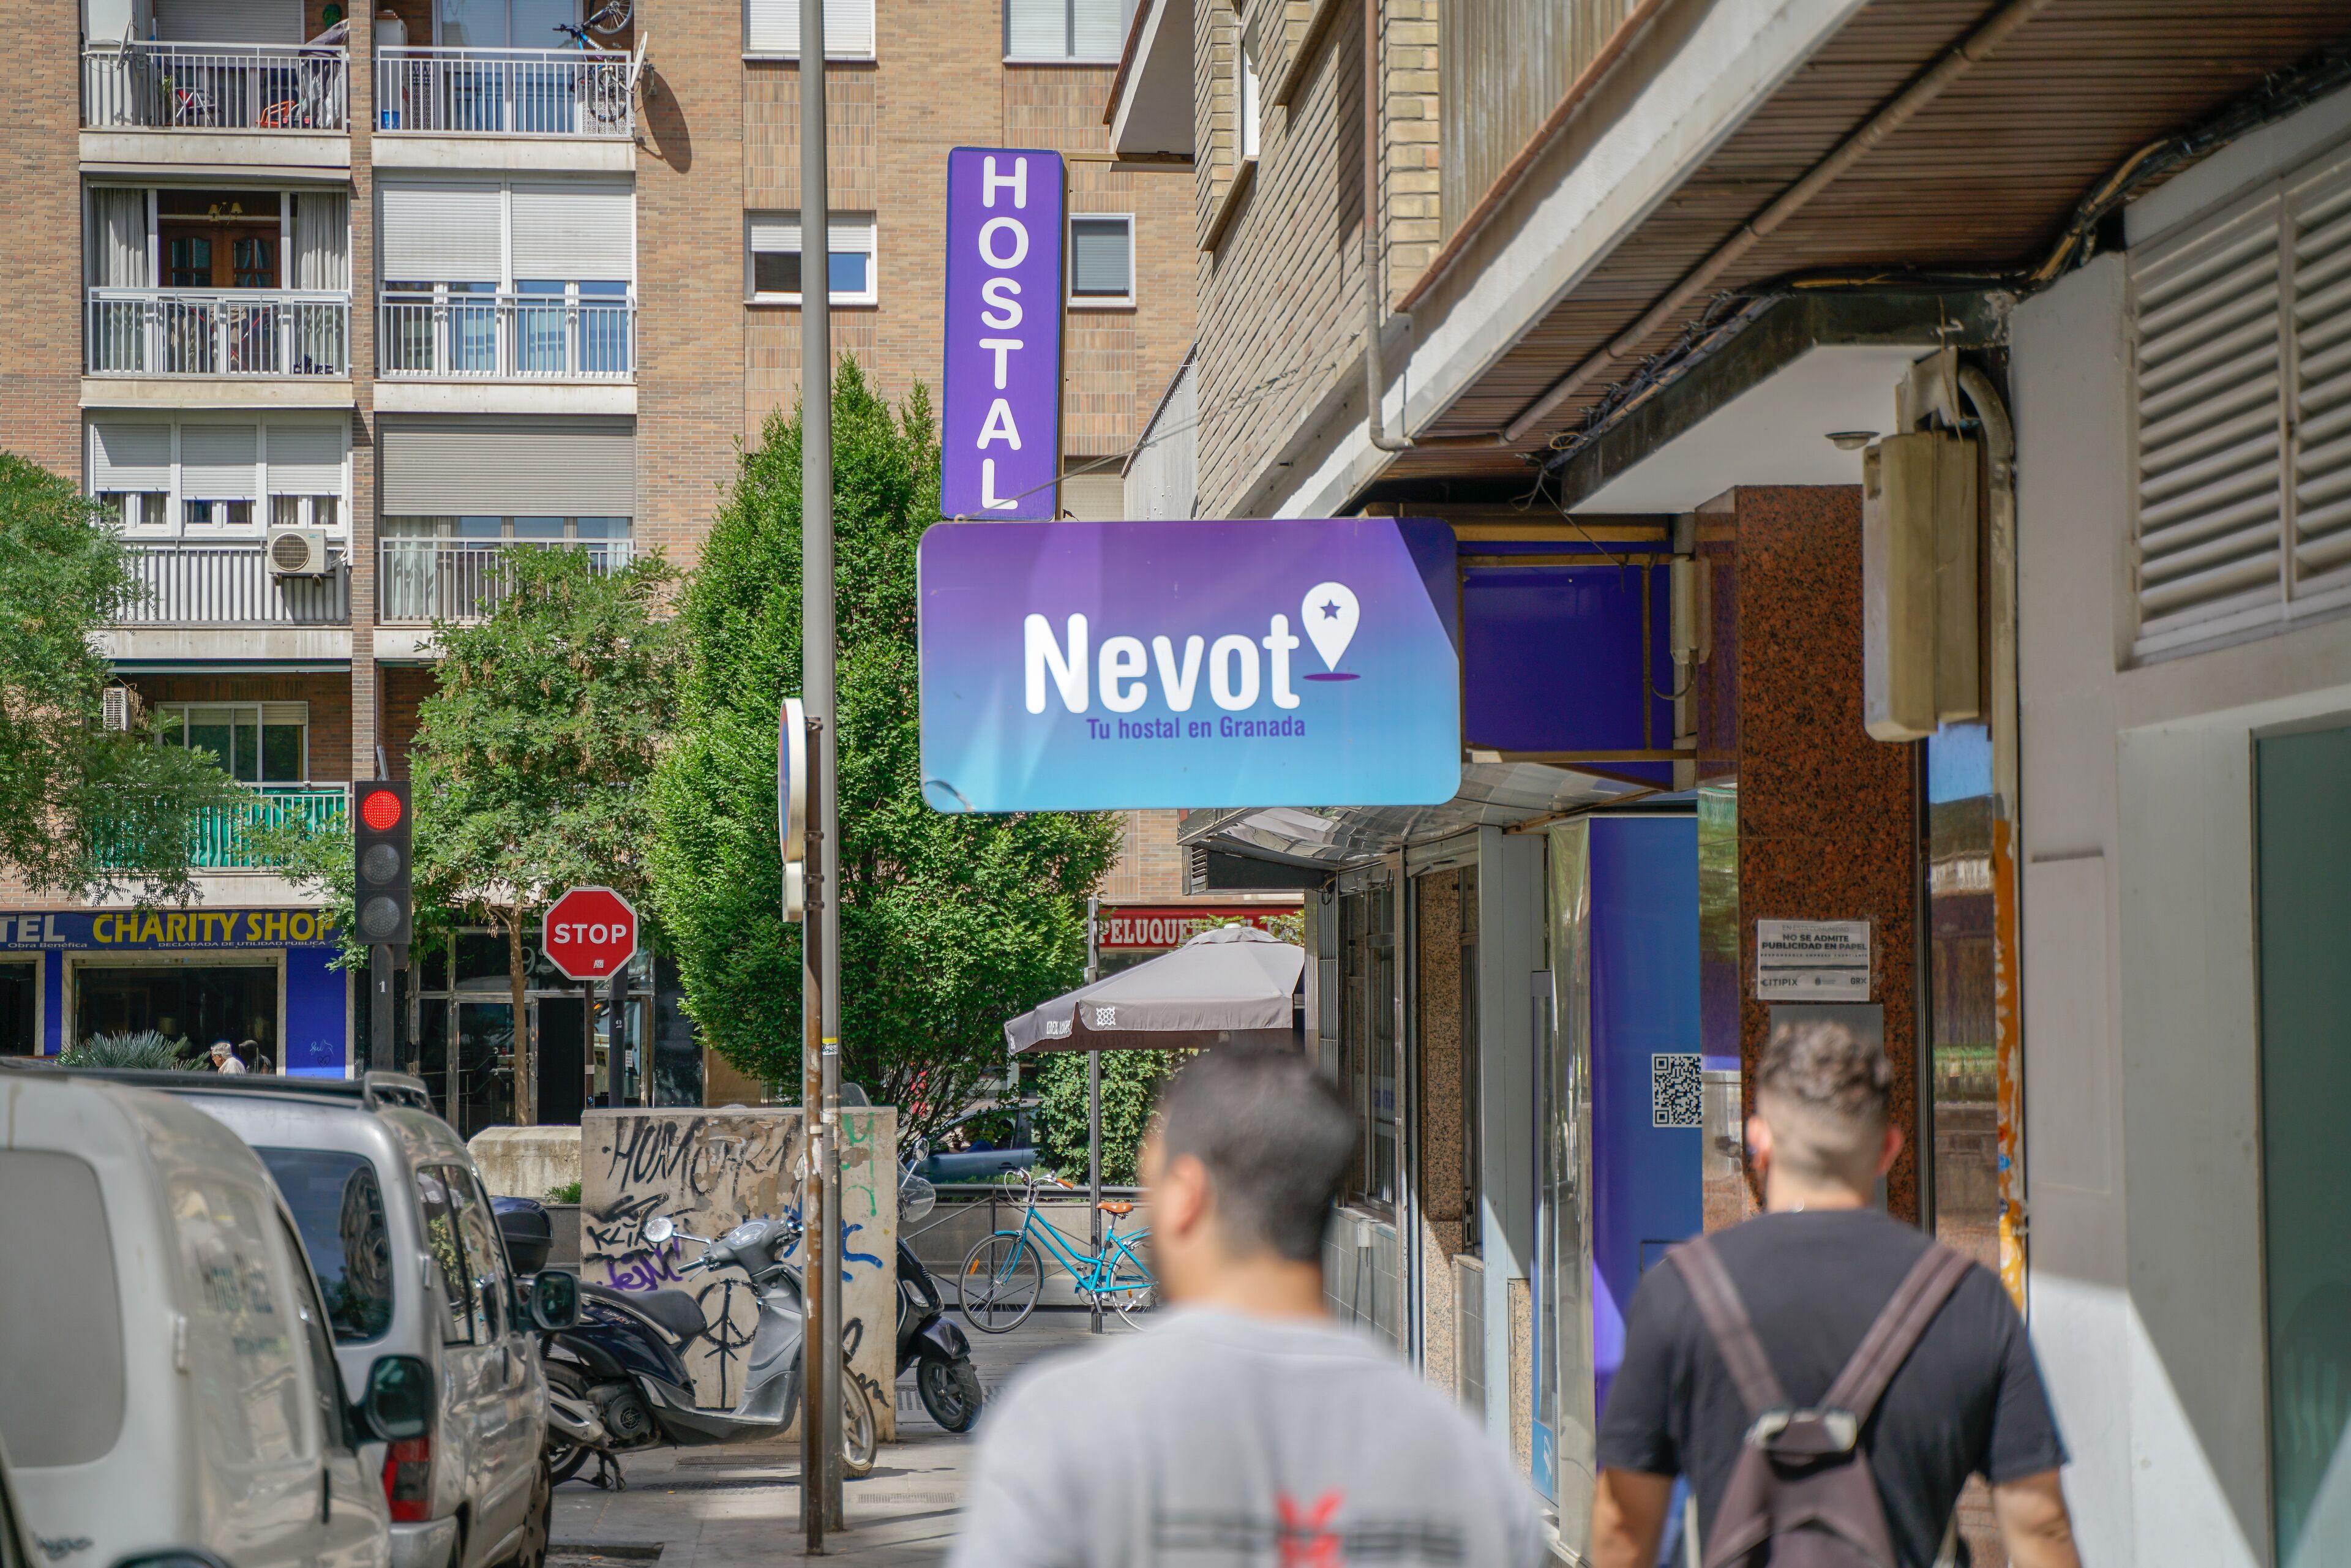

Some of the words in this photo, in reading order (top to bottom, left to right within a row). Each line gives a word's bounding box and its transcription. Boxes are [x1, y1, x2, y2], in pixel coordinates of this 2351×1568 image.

[977, 156, 1029, 510] HOSTAL
[1024, 612, 1301, 715] Nevot
[1086, 718, 1111, 740] Tu
[1119, 716, 1180, 740] hostal
[1188, 720, 1212, 738] en
[1219, 715, 1306, 737] Granada
[92, 912, 240, 943] CHARITY
[246, 912, 334, 942] SHOP
[553, 923, 627, 944] STOP
[1761, 941, 1822, 950] PUBLICIDAD
[379, 981, 386, 992] 1
